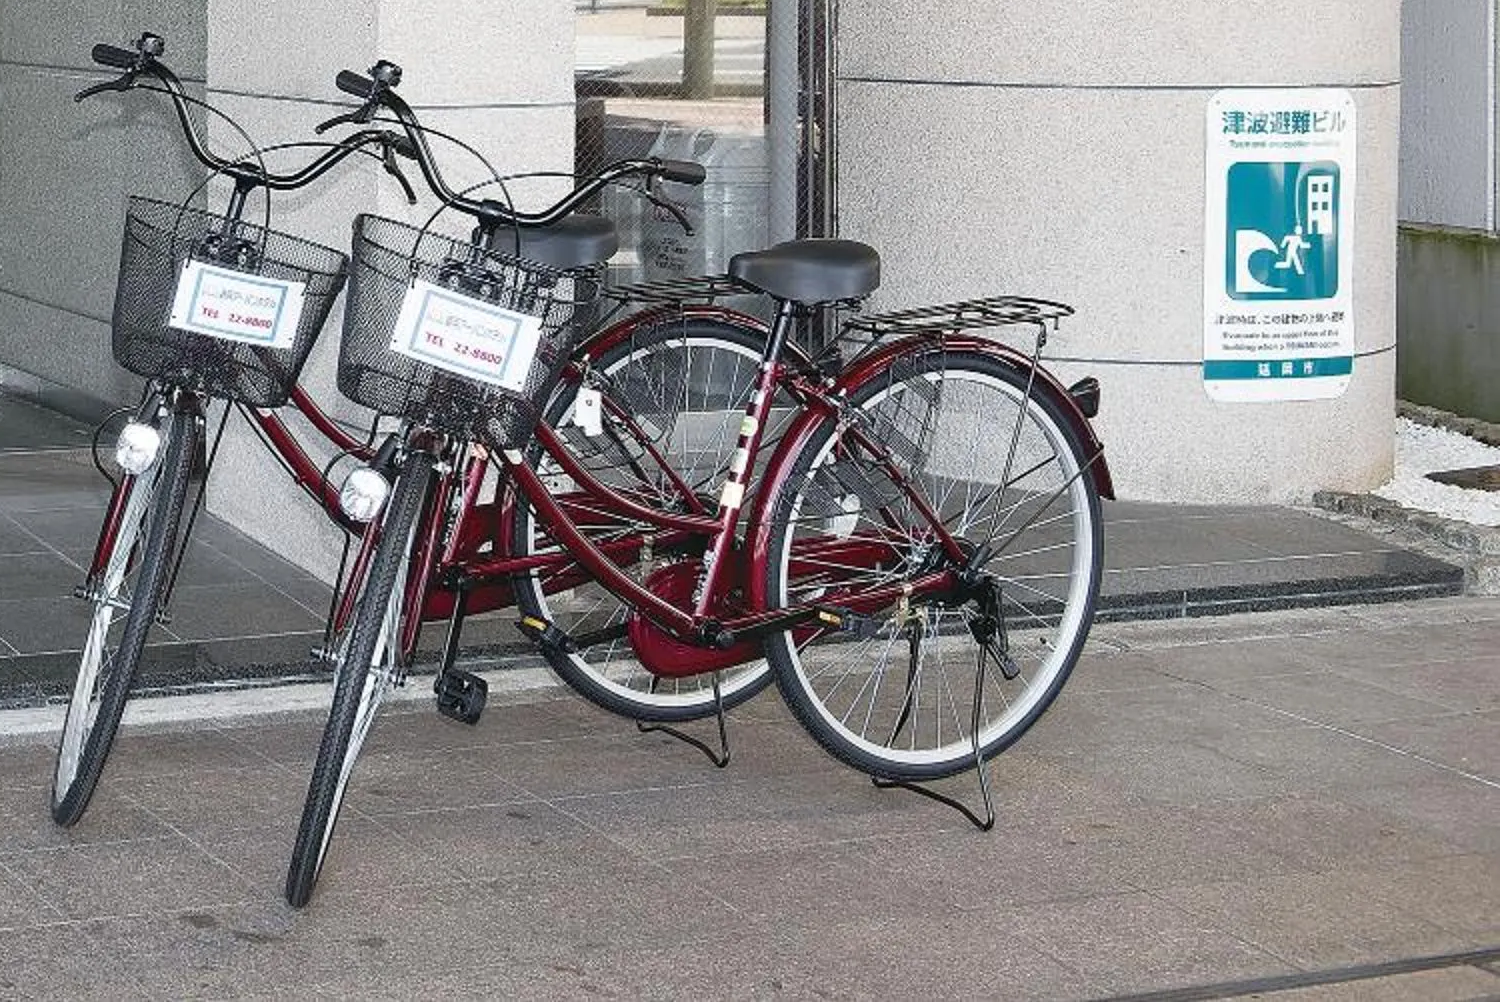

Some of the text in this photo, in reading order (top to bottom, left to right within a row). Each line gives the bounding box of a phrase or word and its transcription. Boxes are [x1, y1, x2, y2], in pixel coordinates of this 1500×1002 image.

[1221, 110, 1346, 135] 津波避難ビル
[201, 305, 219, 319] TEL
[425, 332, 444, 348] TEL
